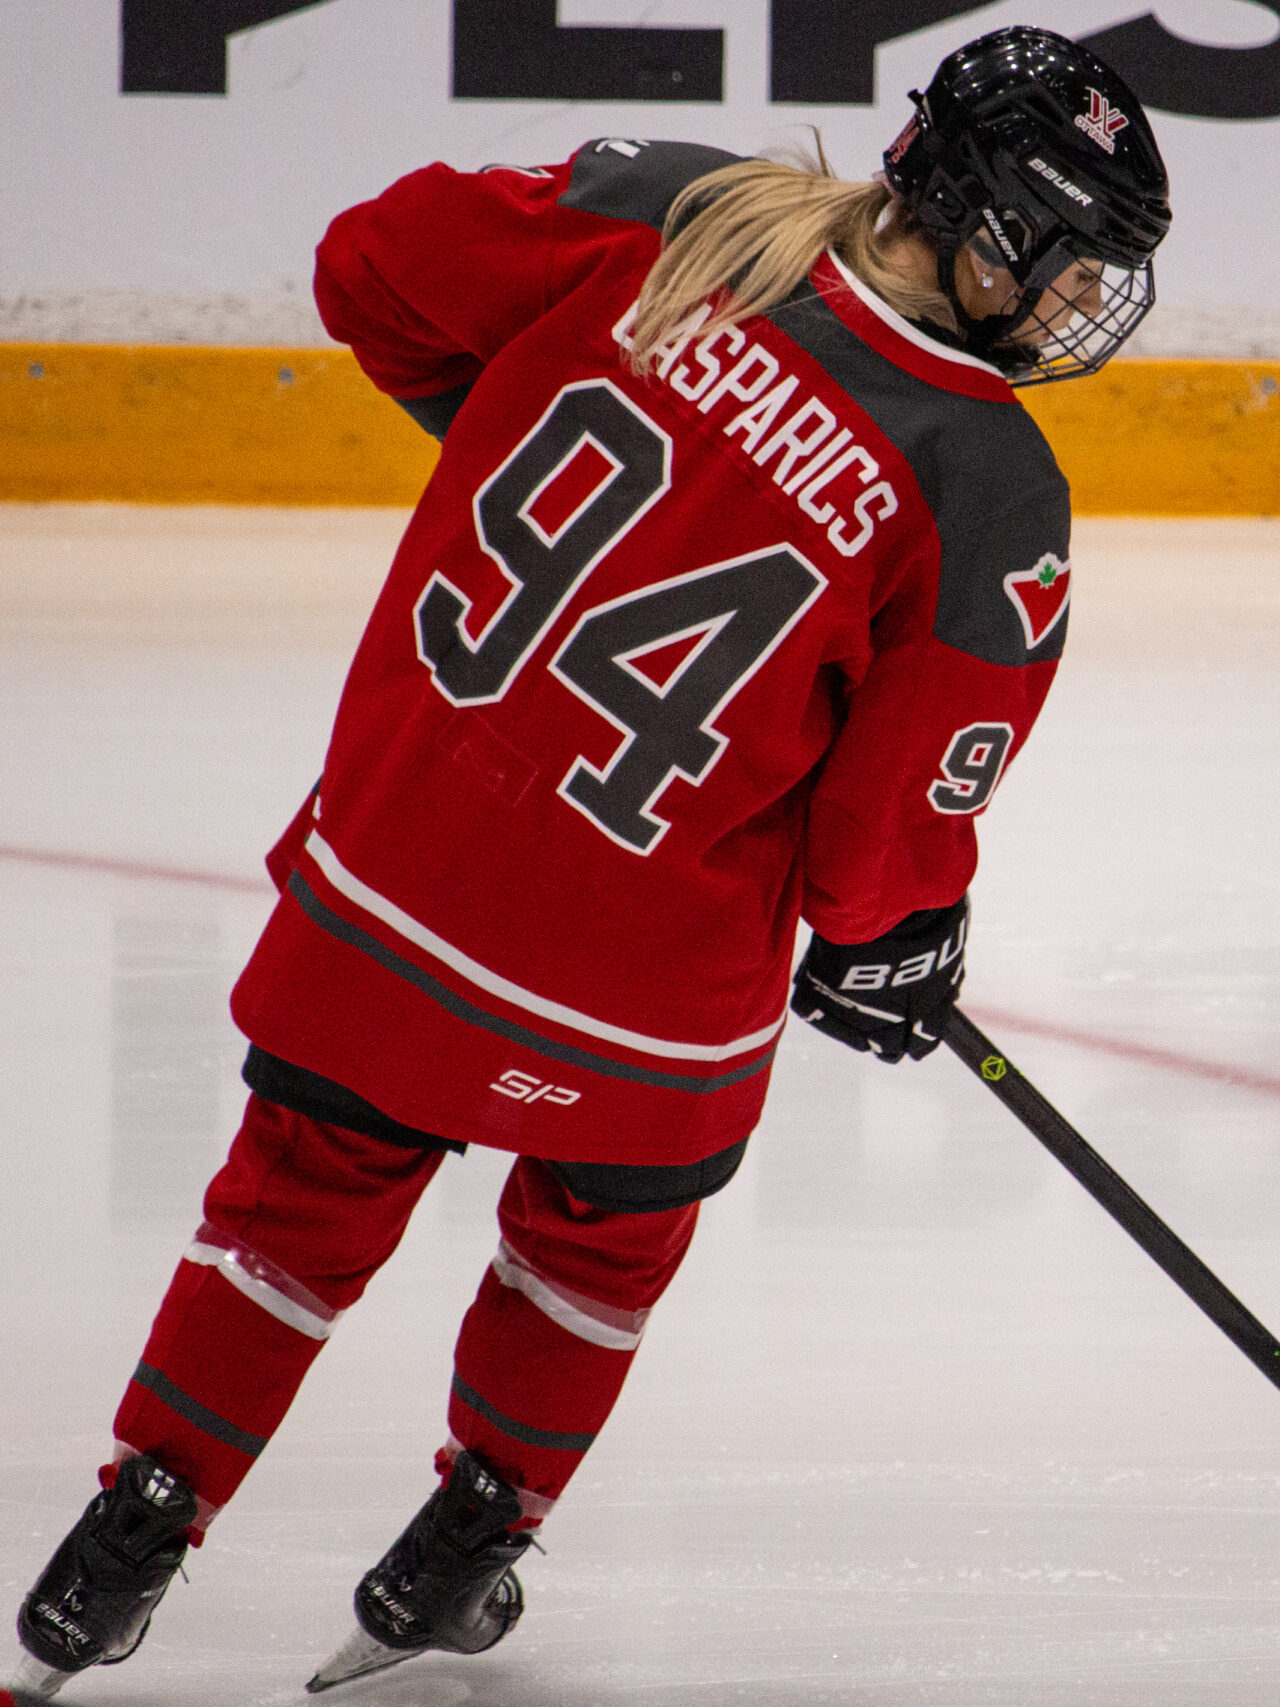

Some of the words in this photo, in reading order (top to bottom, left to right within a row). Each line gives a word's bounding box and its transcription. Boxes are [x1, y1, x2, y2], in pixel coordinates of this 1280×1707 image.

[1074, 114, 1115, 155] OTTAWA
[1028, 157, 1093, 207] BAUER
[982, 208, 1019, 262] BAUER
[412, 377, 830, 857] 94
